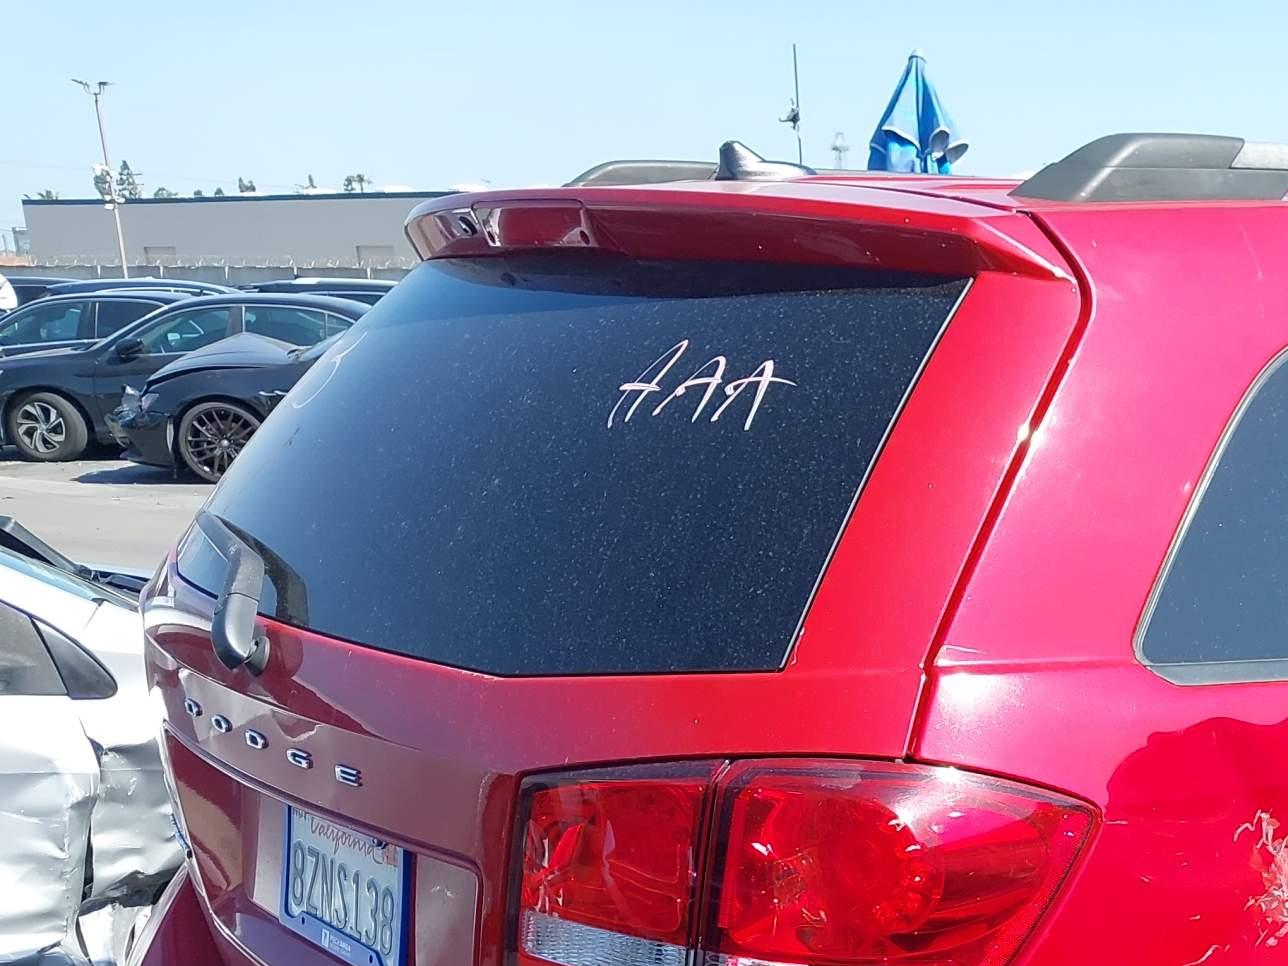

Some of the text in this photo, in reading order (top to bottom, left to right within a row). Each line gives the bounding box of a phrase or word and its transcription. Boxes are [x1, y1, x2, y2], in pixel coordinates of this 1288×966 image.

[608, 339, 798, 432] AAA
[185, 697, 364, 788] DODGE
[292, 840, 395, 957] 8ZNS138
